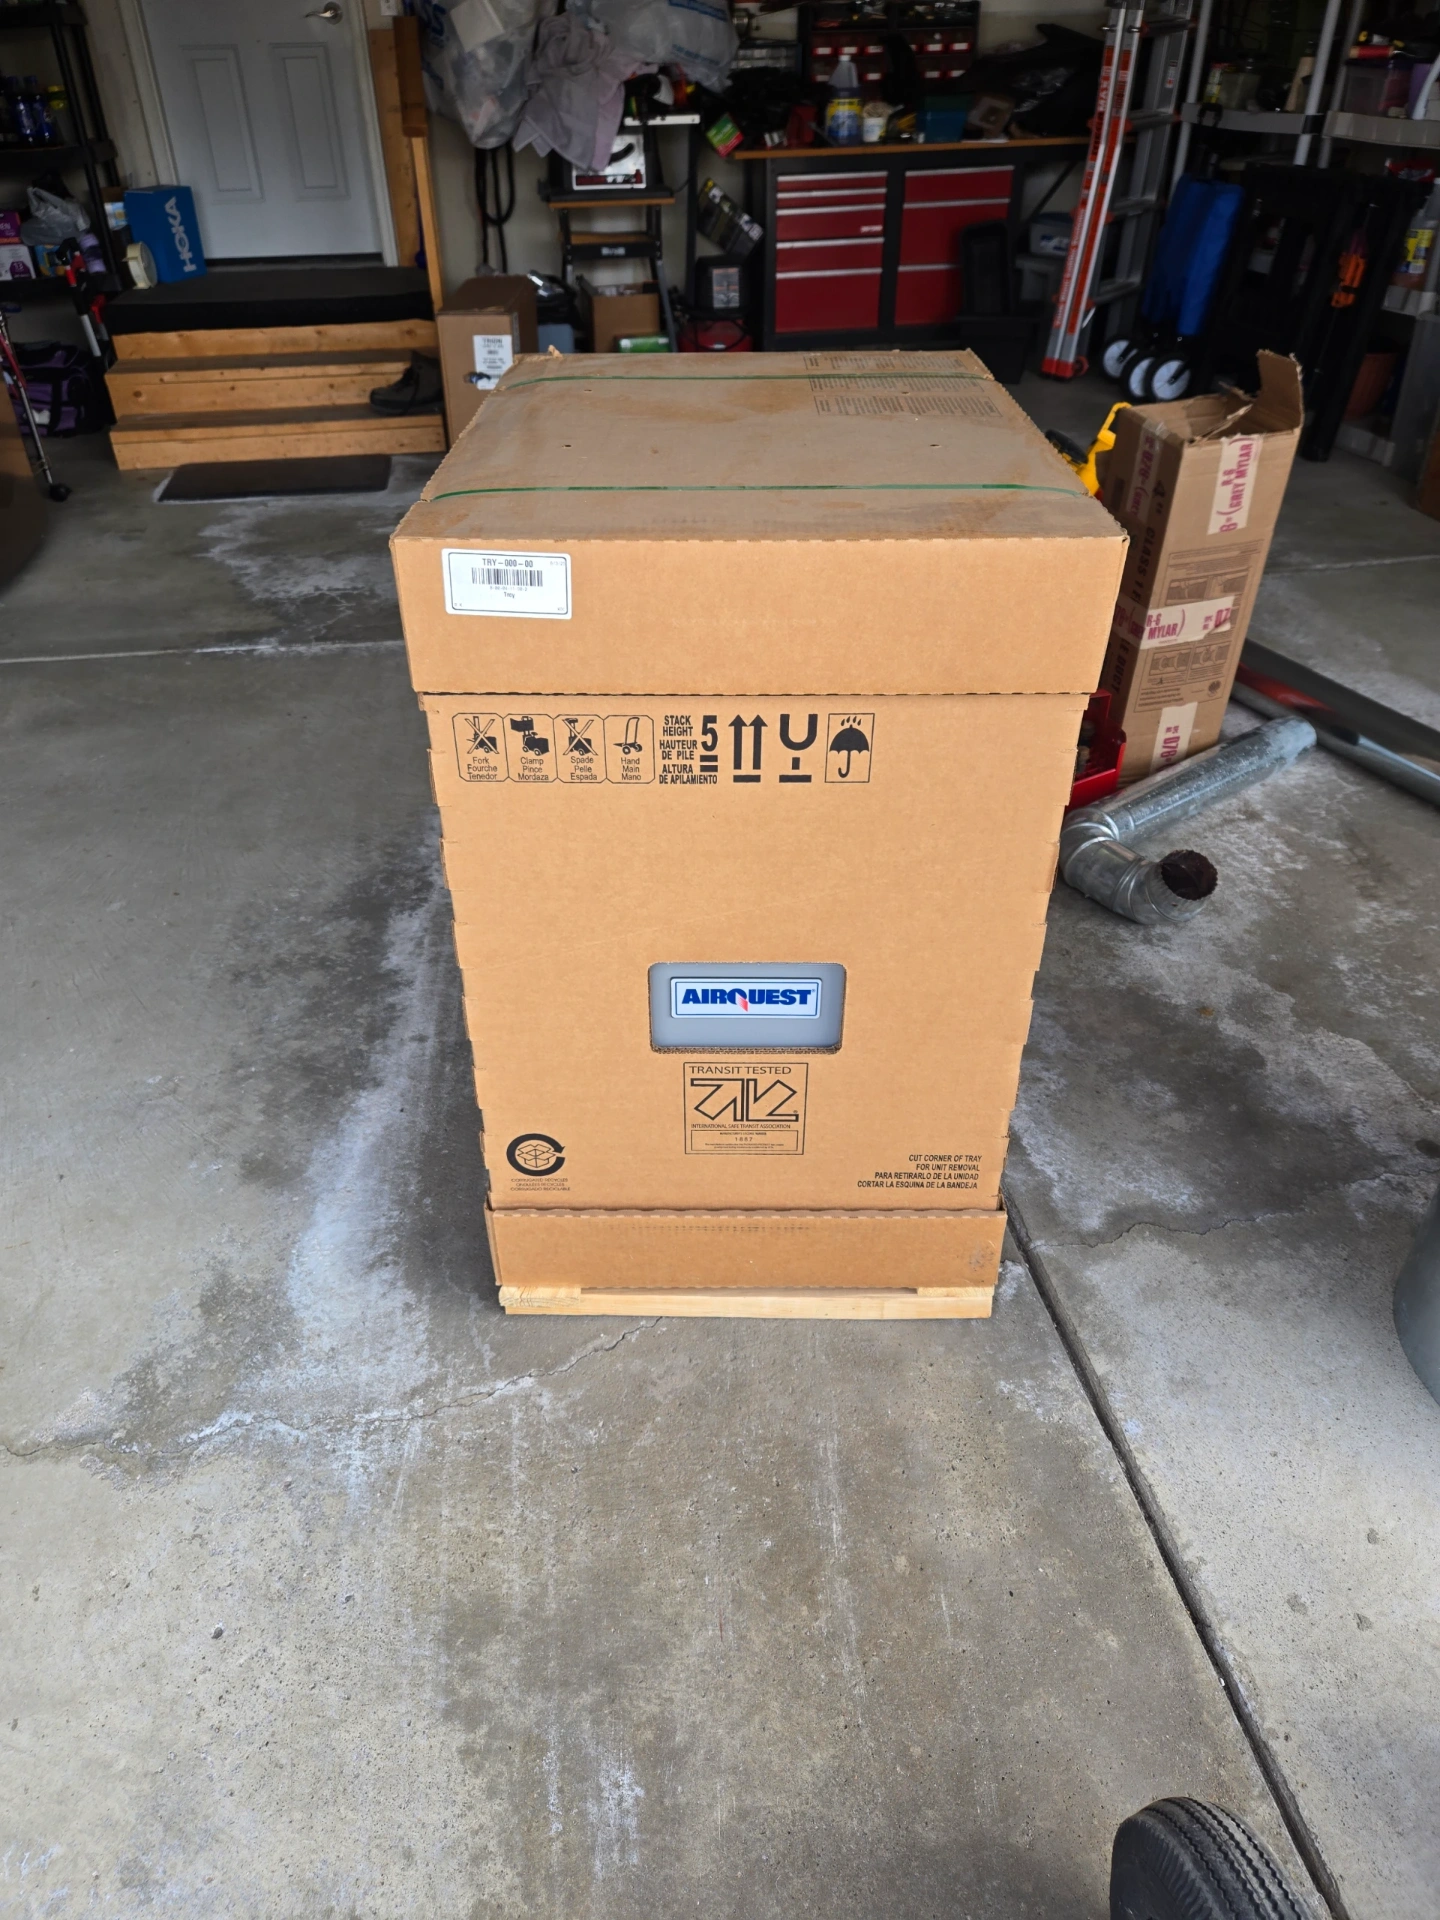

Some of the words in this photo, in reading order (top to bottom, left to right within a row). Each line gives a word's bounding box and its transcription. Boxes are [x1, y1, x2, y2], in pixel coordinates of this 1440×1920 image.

[165, 196, 197, 272] HOKA
[1138, 526, 1155, 577] CLASS
[664, 715, 691, 726] STACK
[662, 726, 693, 736] HEIGHT
[700, 714, 718, 752] 5
[660, 740, 698, 750] HAUTEUR
[472, 756, 490, 764] Fork
[662, 750, 672, 760] DE
[676, 750, 694, 760] PILE
[520, 756, 544, 766] Clamp
[570, 756, 594, 766] Spade
[620, 757, 640, 765] Hand
[467, 764, 498, 772] Fourche
[574, 765, 592, 773] Pelle
[622, 765, 640, 773] Main
[662, 764, 694, 774] ALTURA
[467, 772, 498, 780] Tenedor
[518, 772, 548, 780] Mordaza
[570, 772, 598, 782] Espada
[658, 774, 668, 784] DE
[670, 774, 718, 784] APILAMIENTO
[682, 988, 812, 1012] AIRQUEST
[689, 1066, 742, 1074] TRANSIT
[744, 1066, 792, 1074] TESTED
[908, 1154, 923, 1162] CUT
